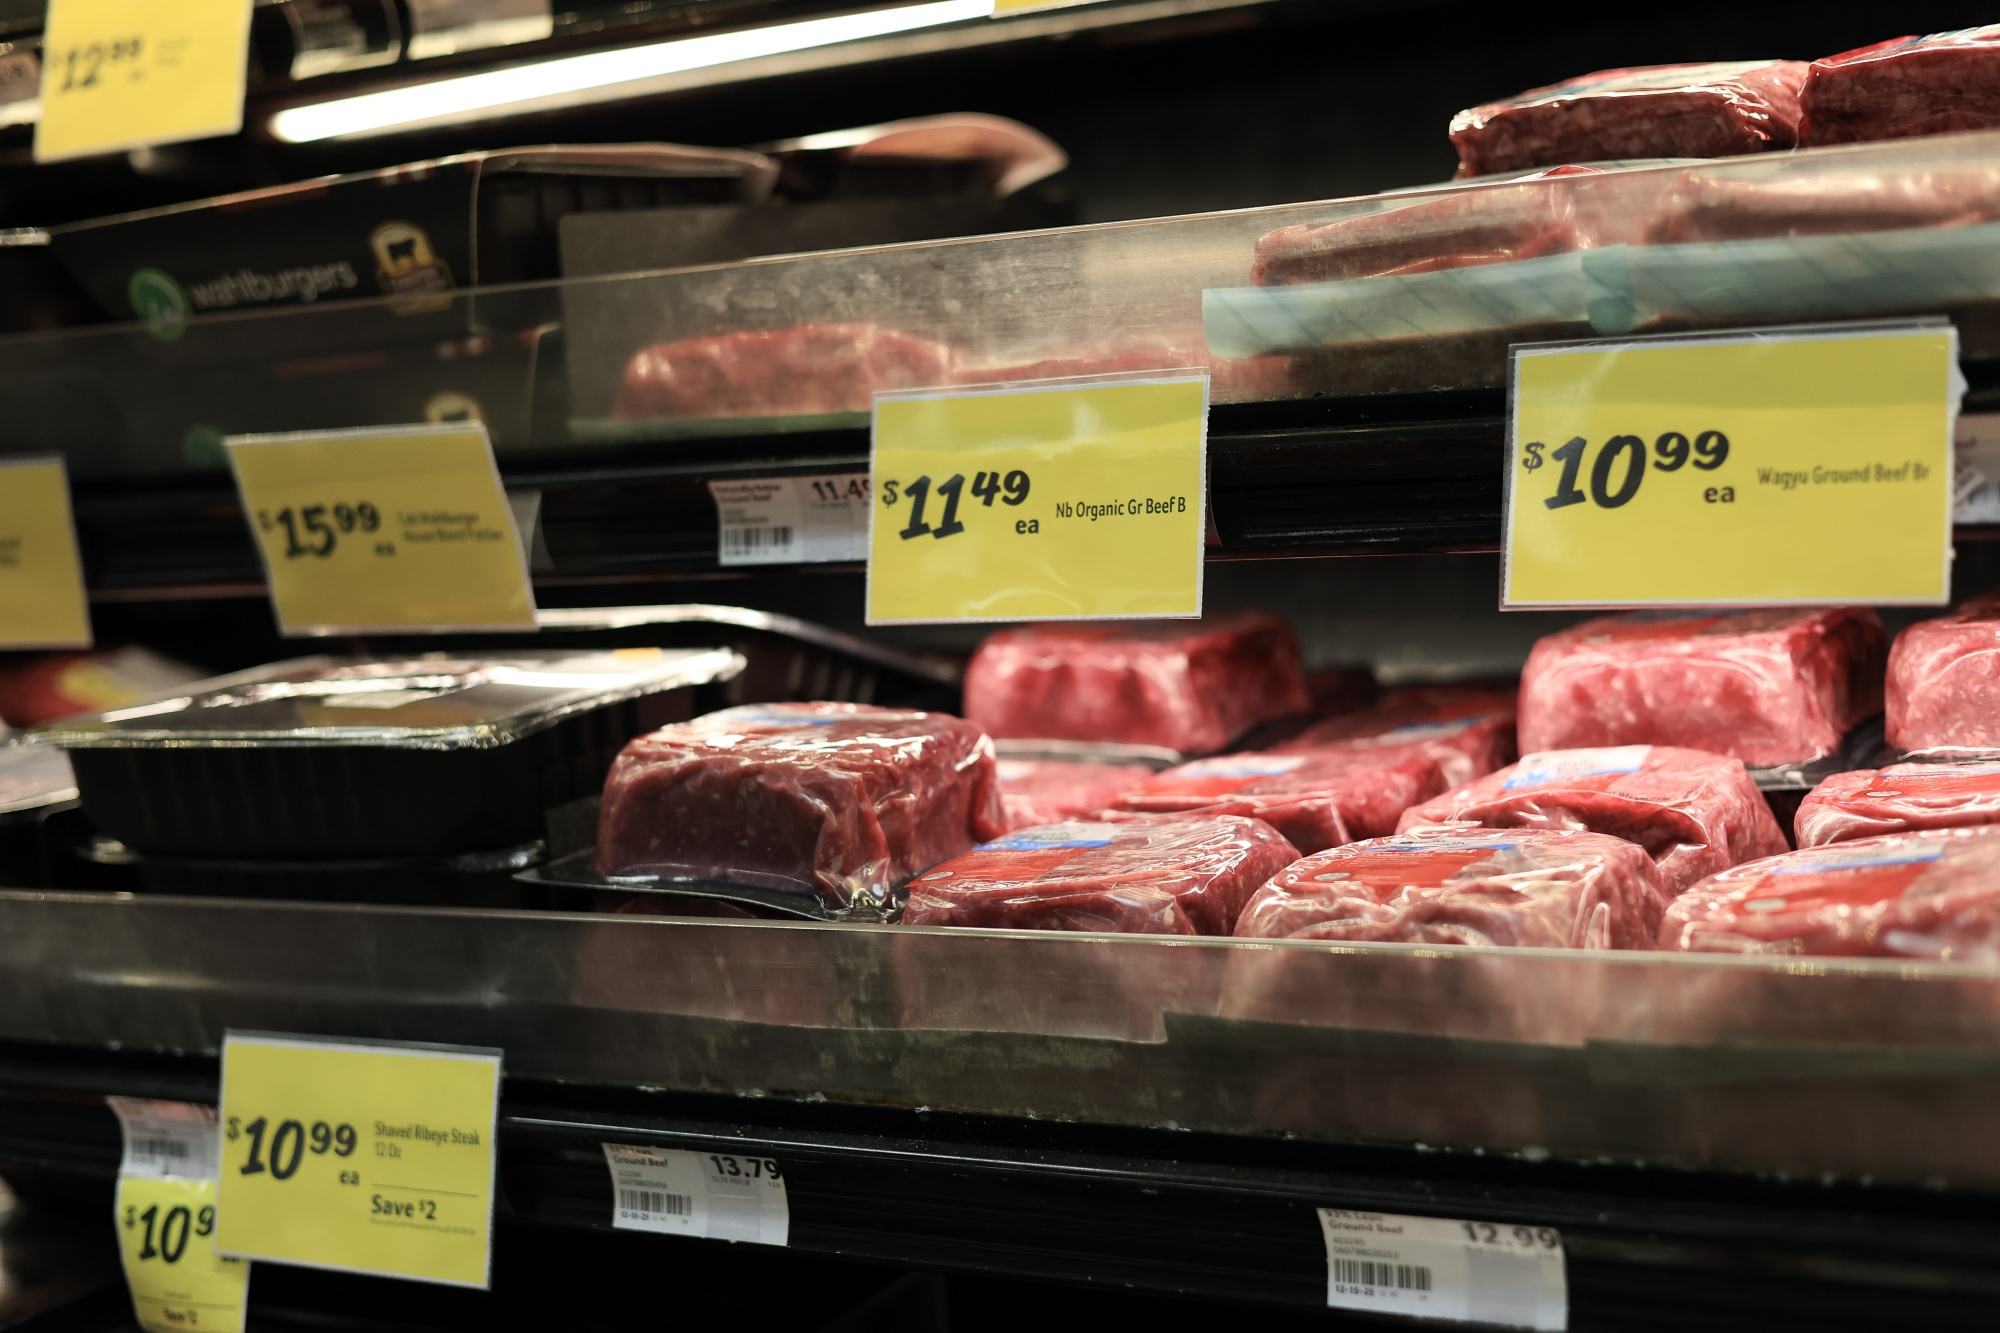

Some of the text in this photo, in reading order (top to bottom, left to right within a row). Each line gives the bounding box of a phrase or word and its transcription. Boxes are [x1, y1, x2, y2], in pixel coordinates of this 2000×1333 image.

[1757, 467, 1808, 490] Wagyu
[1812, 464, 1870, 485] Ground
[1874, 462, 1909, 482] Beef
[1703, 485, 1736, 504] ea
[1056, 502, 1073, 519] Nb
[1076, 499, 1124, 521] Organic
[1128, 499, 1143, 515] Gr
[1146, 496, 1176, 514] Beef
[1015, 519, 1040, 534] ea
[375, 1120, 481, 1145] Shaved Ribeye Steak
[613, 1154, 669, 1168] Ground Beef
[710, 1155, 782, 1180] 13.79
[339, 1171, 360, 1185] ea
[371, 1194, 414, 1217] Save
[1328, 1220, 1404, 1234] Ground Beef
[1462, 1221, 1558, 1249] 12.99
